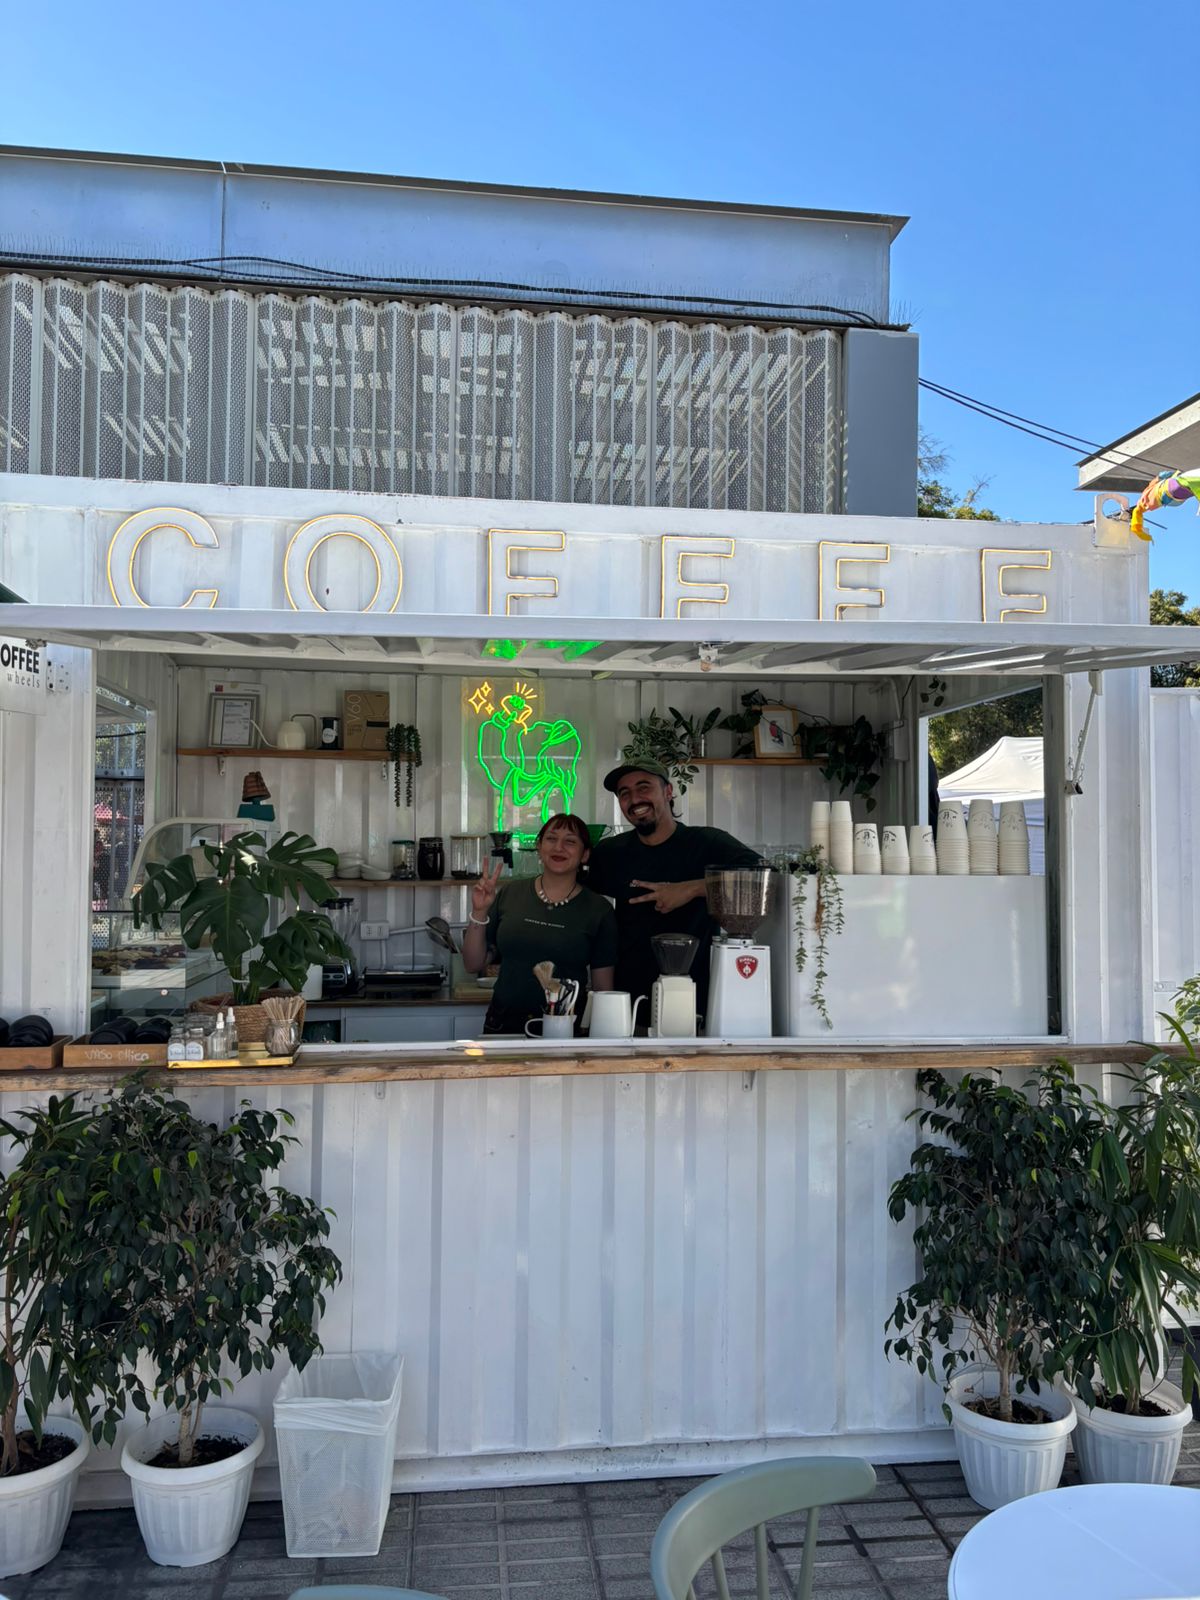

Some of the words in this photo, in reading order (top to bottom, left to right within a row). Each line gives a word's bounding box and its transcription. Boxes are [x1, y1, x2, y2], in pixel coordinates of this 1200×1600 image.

[0, 643, 40, 674] OFFEE
[7, 671, 40, 688] wheels
[347, 694, 361, 723] V60
